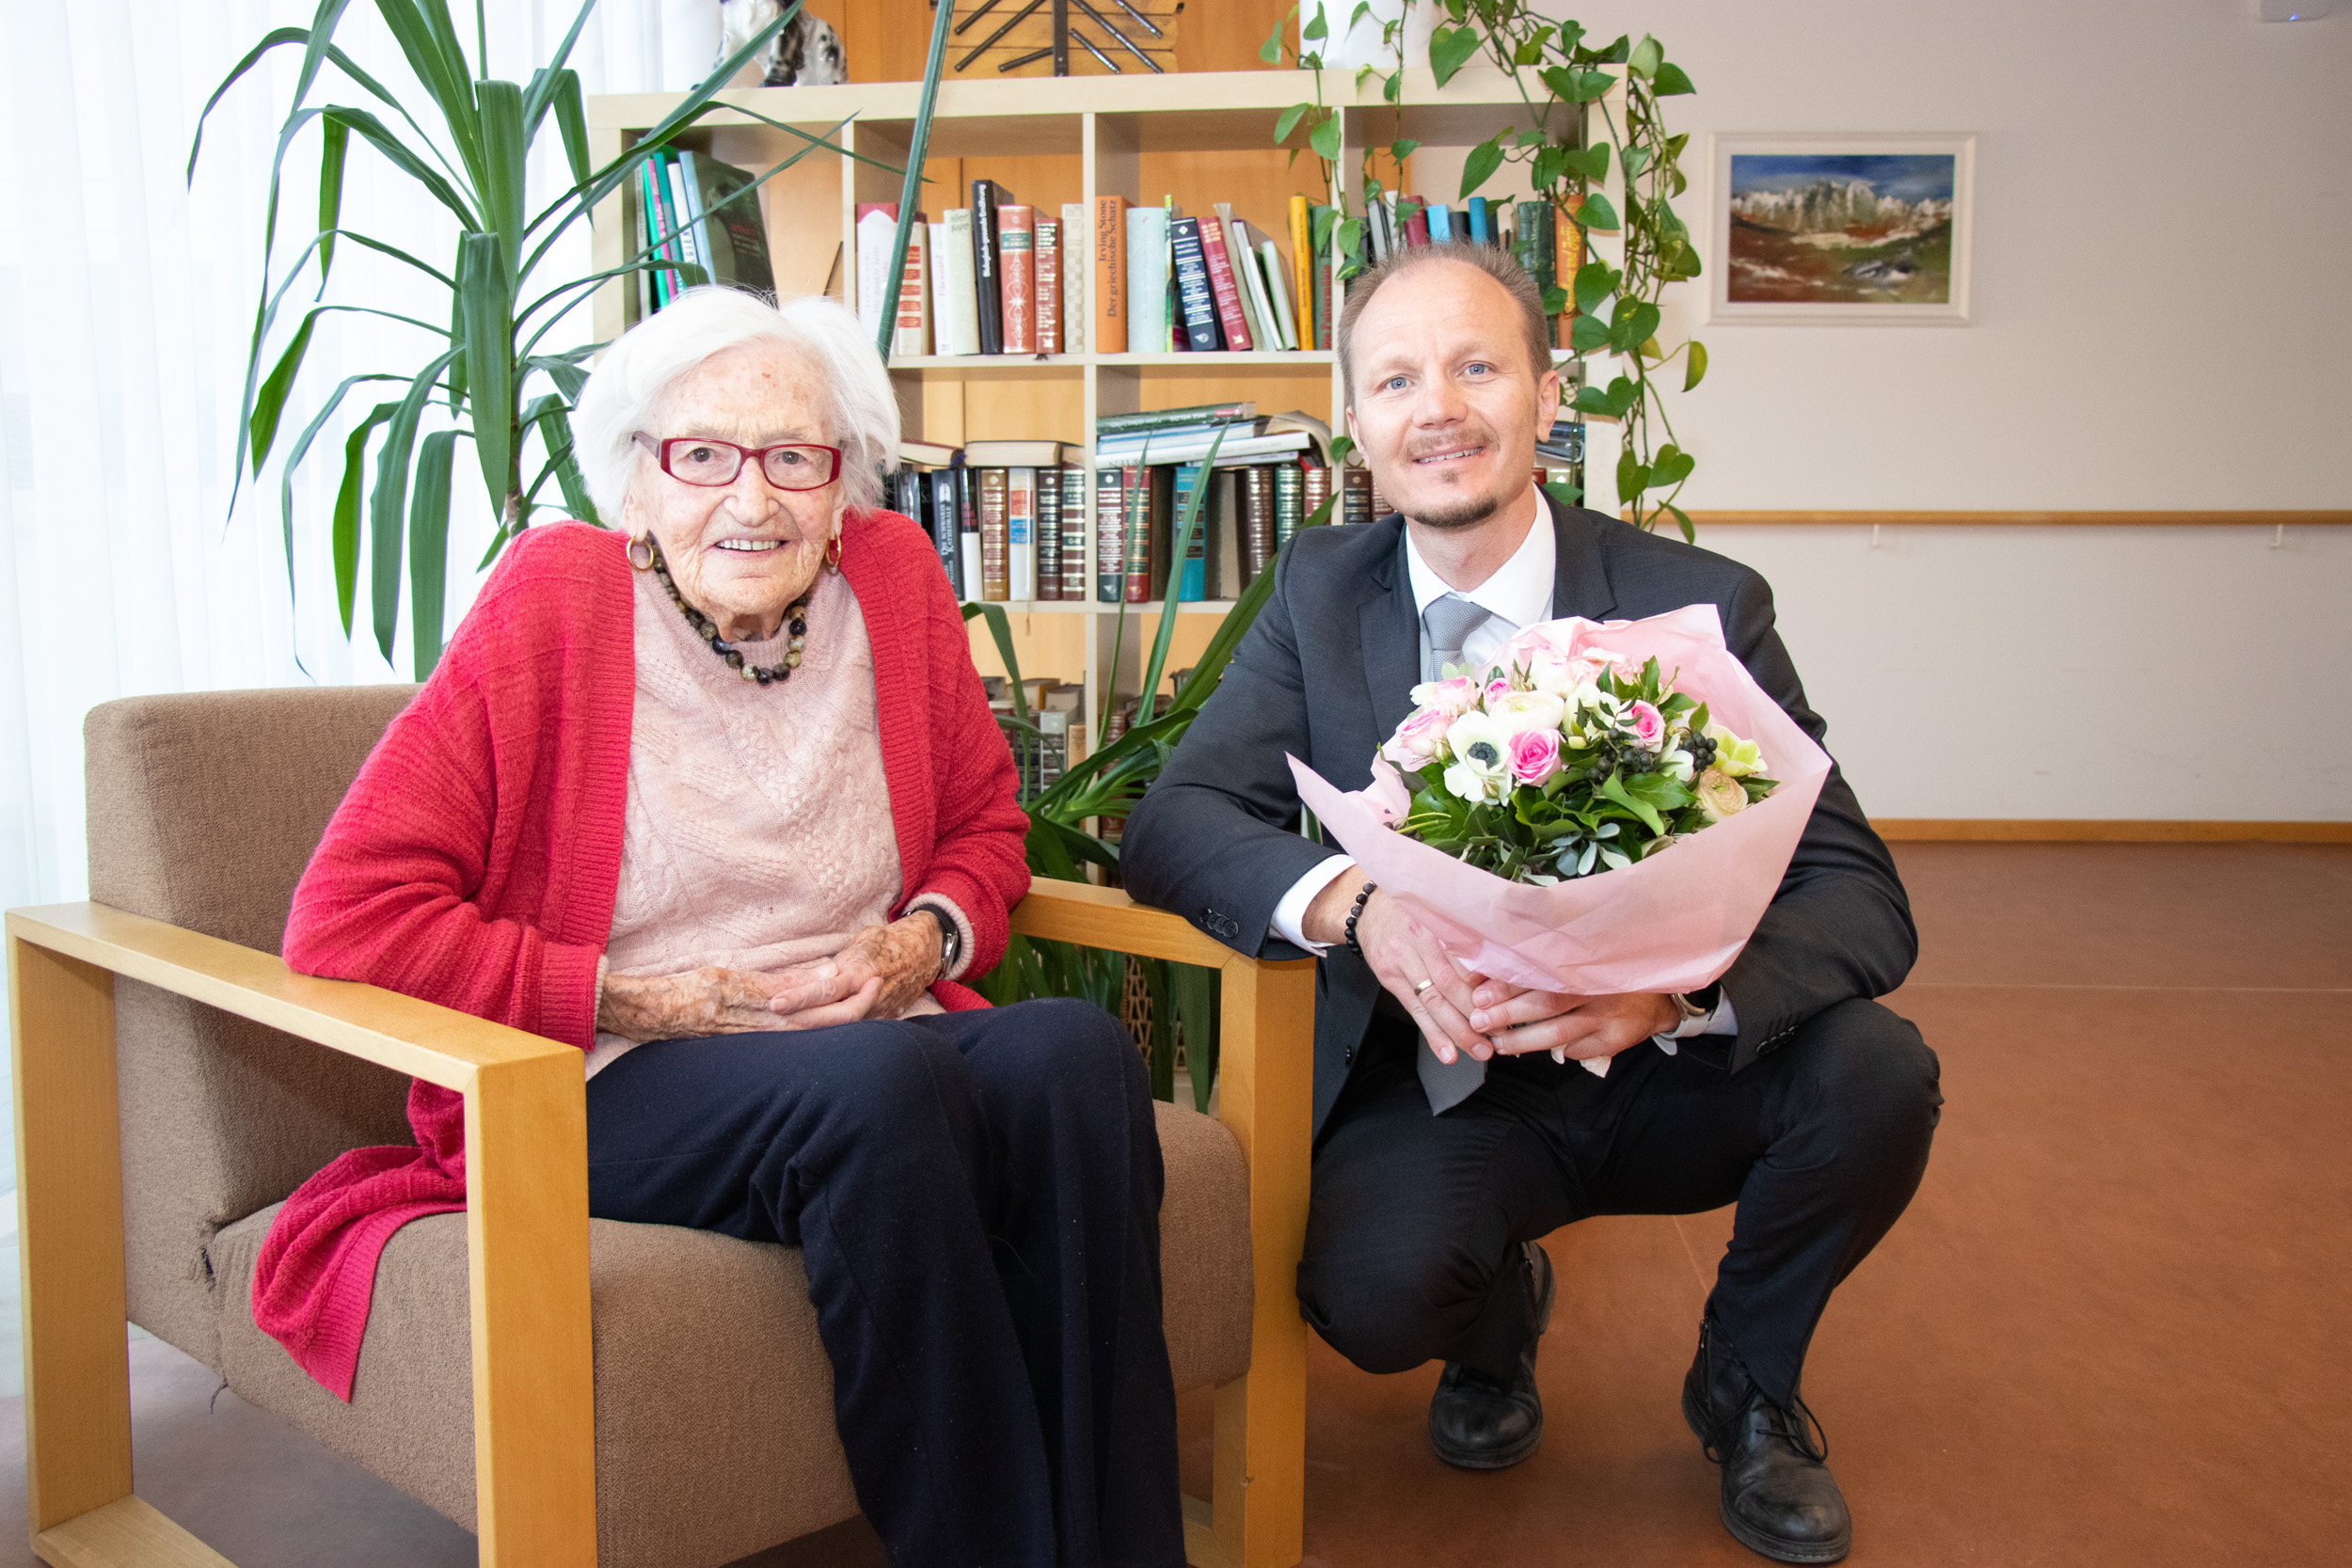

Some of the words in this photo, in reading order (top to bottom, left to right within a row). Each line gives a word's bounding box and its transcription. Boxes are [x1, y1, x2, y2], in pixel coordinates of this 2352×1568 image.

[1098, 199, 1107, 230] Stone
[1107, 199, 1118, 234] Schatz
[1098, 230, 1109, 261] Irving
[1107, 236, 1119, 295] griechische
[1107, 298, 1117, 318] Der
[946, 506, 955, 553] KATHEDRALE
